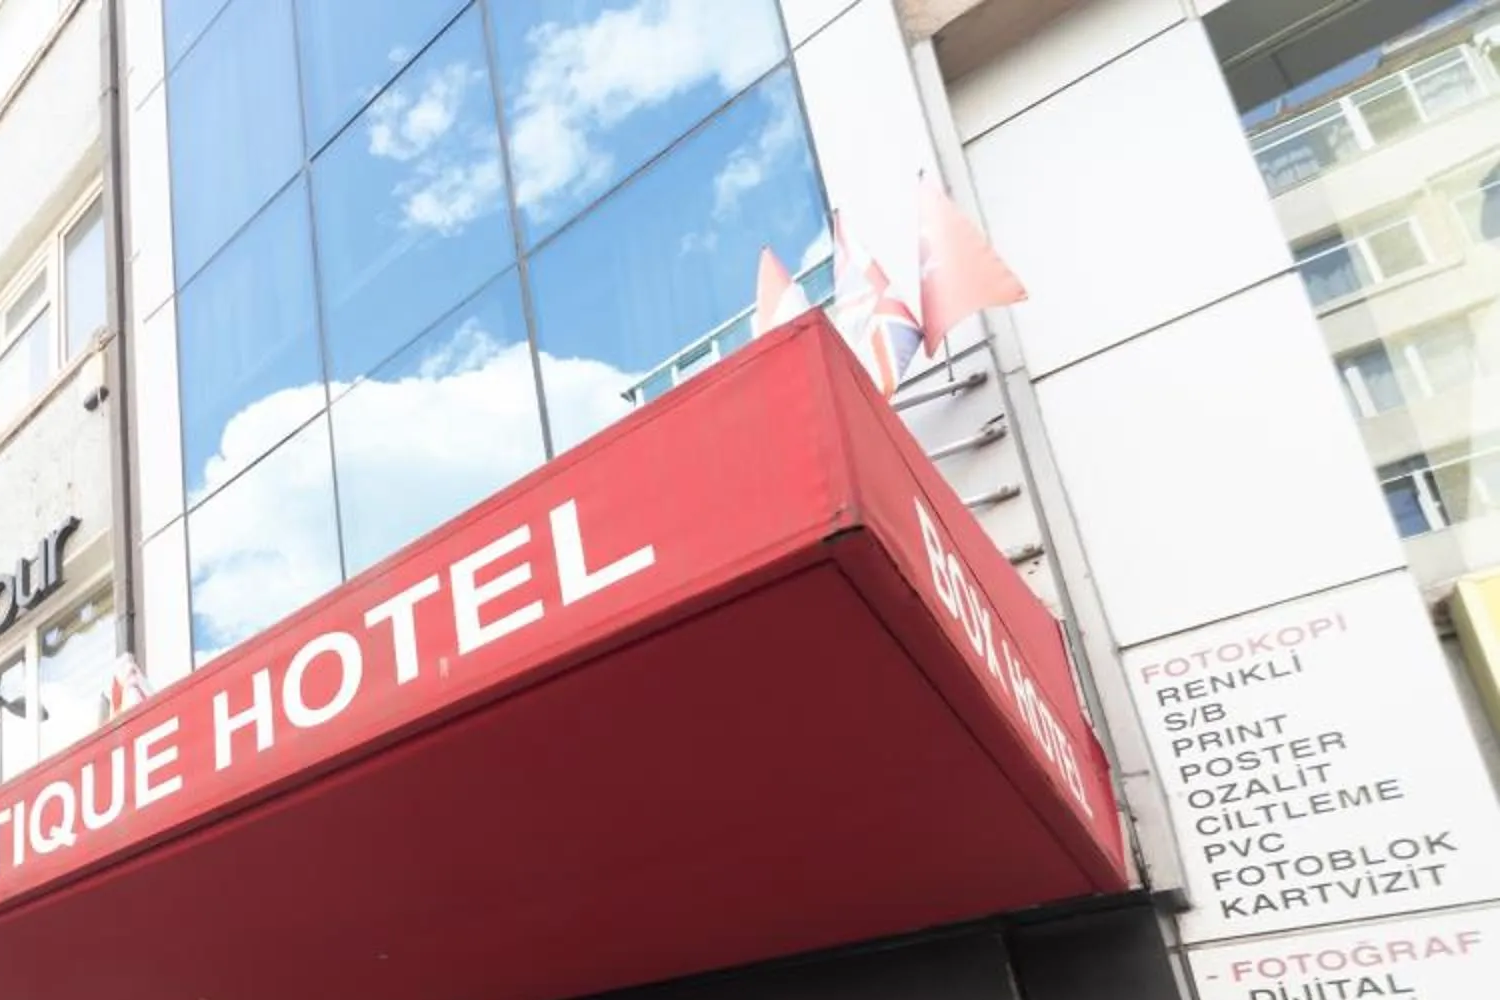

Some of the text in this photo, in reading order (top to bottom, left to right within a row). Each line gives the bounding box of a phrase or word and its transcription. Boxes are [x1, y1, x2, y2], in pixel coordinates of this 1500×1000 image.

[213, 499, 655, 772] HOTEL
[914, 496, 1093, 817] BOX HOTEL
[1157, 649, 1303, 706] RENKLİ
[1164, 703, 1226, 732] S/B
[1172, 714, 1288, 757] PRINT
[1180, 731, 1347, 784] POSTER
[1188, 763, 1331, 809] OZALİT
[1195, 779, 1403, 836] CİLTLEME
[1204, 833, 1285, 863] PVC
[1213, 831, 1458, 890] FOTOBLOK
[1220, 864, 1447, 919] KARTVİZİT
